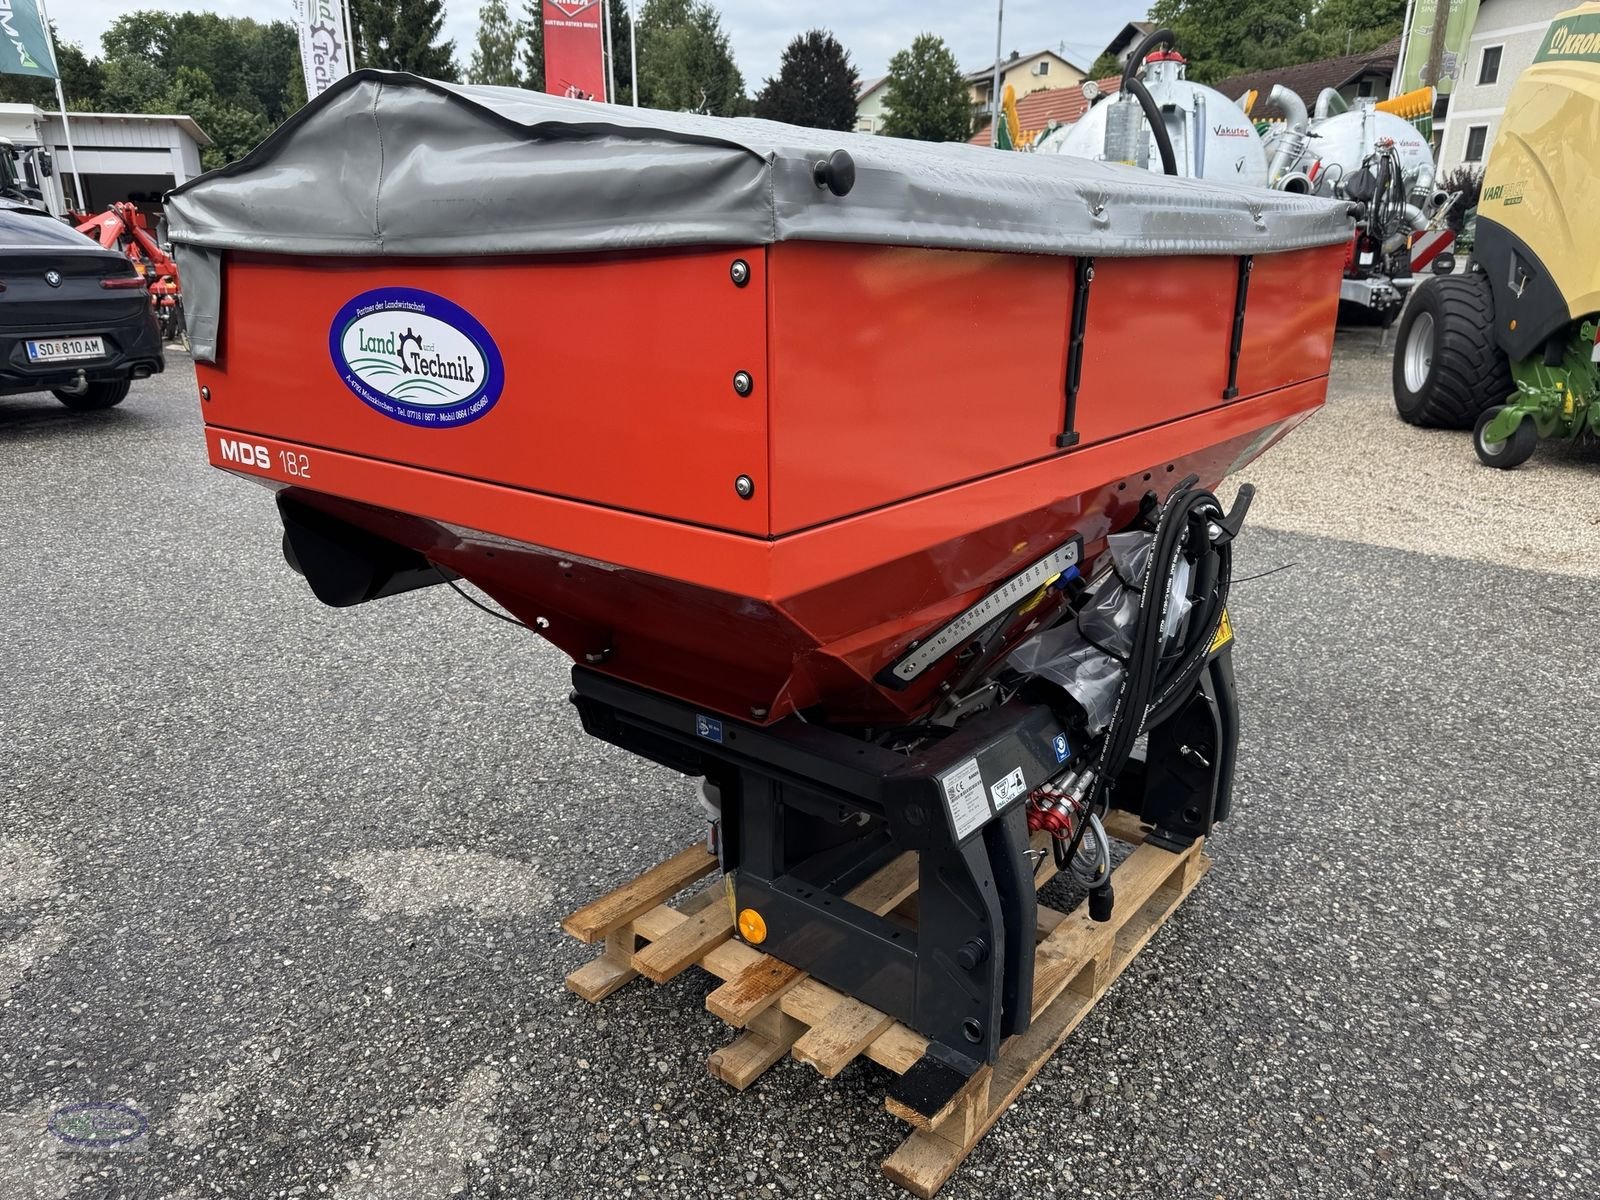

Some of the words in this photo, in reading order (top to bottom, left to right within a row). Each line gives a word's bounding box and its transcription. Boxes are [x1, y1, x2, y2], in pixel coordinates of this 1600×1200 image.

[1213, 124, 1249, 137] Vakutec
[356, 305, 375, 318] Partner
[374, 301, 384, 310] der
[384, 299, 426, 312] Landwirtschaft
[39, 343, 54, 356] SD
[62, 341, 82, 354] 810
[84, 340, 100, 353] AM
[359, 327, 396, 356] Land
[423, 343, 435, 352] und
[410, 353, 475, 383] Technik
[220, 438, 271, 470] MDS
[279, 450, 312, 479] 18.2
